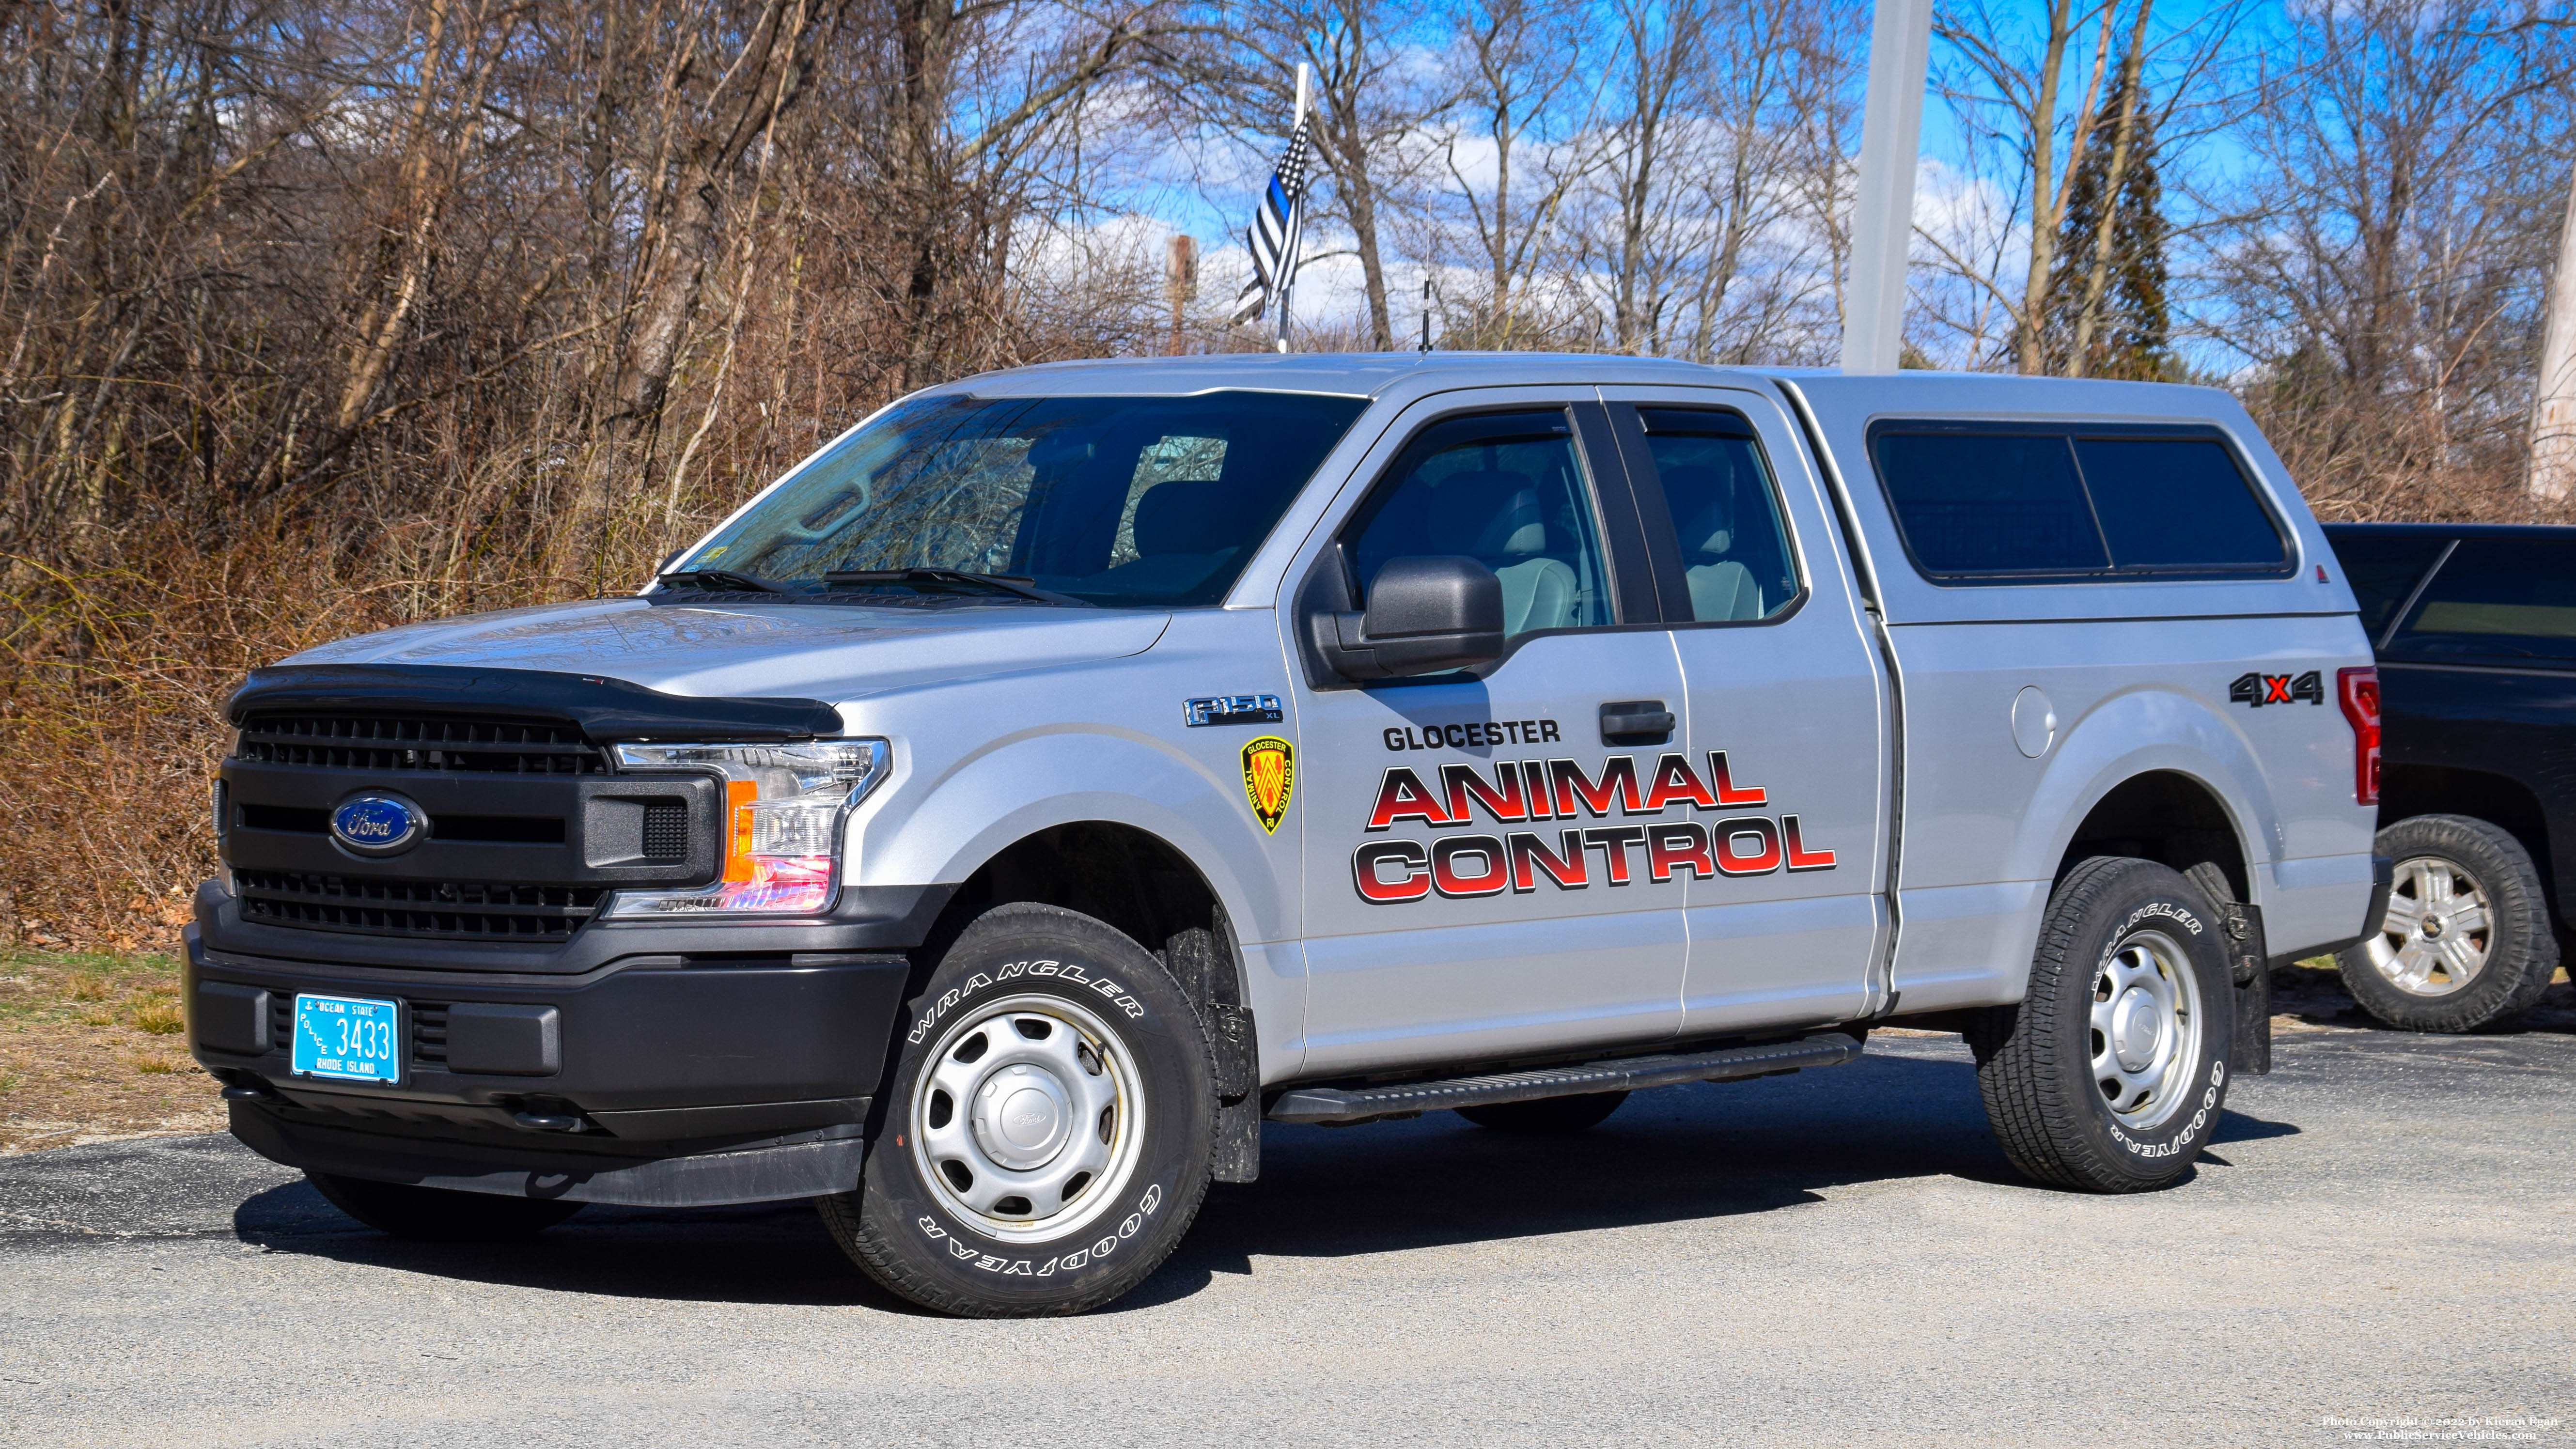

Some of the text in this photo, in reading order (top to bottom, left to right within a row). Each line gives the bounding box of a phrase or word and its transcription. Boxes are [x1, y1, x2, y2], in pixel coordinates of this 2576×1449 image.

[1248, 741, 1286, 754] GLOCESTER
[1384, 720, 1560, 751] GLOCESTER
[1246, 767, 1262, 810] ANIMAL
[1275, 759, 1291, 813] CONTROL
[1365, 750, 1768, 832] ANIMAL
[347, 804, 394, 837] Ford
[1266, 818, 1274, 827] RI
[1352, 814, 1837, 905] CONTROL
[319, 1002, 373, 1016] OCEAN STATE
[908, 960, 1144, 1044] WRANGLER
[300, 1013, 328, 1054] POLICE
[336, 1018, 389, 1060] 3433
[316, 1058, 375, 1074] RHODE ISLAND
[2109, 1061, 2224, 1157] GOODYEAR
[919, 1184, 1161, 1276] GOODYEAR
